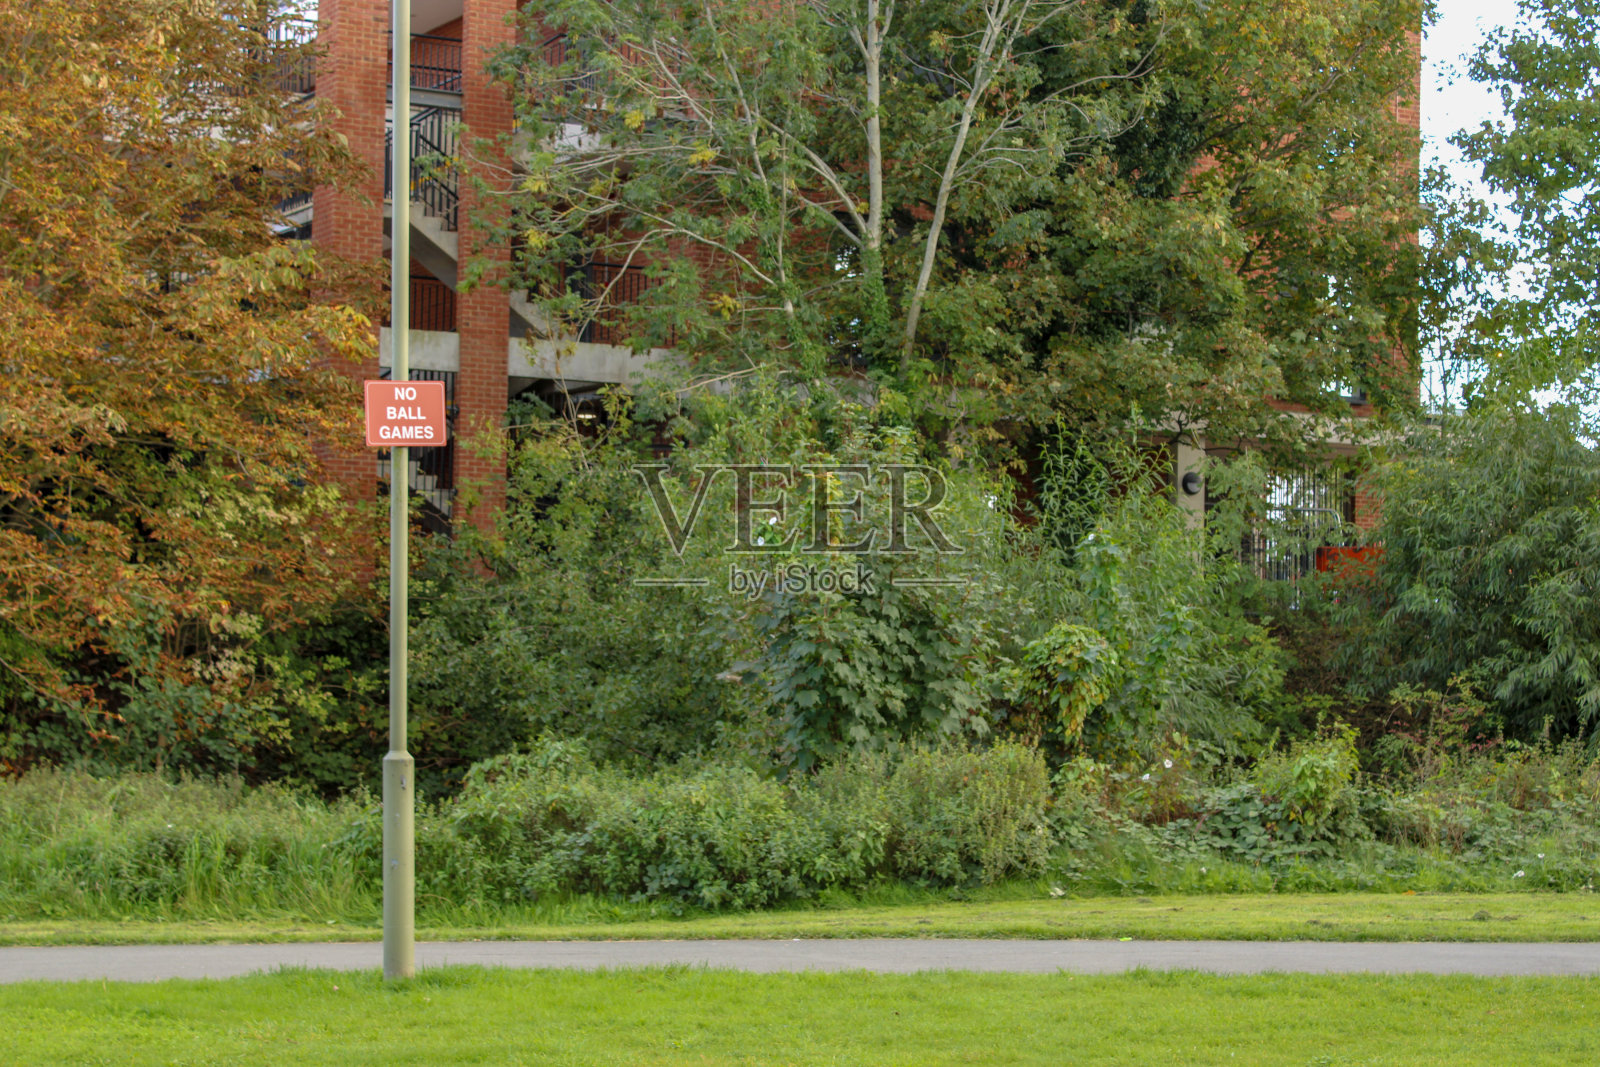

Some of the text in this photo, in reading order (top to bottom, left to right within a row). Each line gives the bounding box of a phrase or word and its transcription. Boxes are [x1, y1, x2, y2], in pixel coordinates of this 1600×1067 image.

[394, 387, 417, 400] NO
[386, 406, 426, 420] BALL
[379, 425, 434, 439] GAMES
